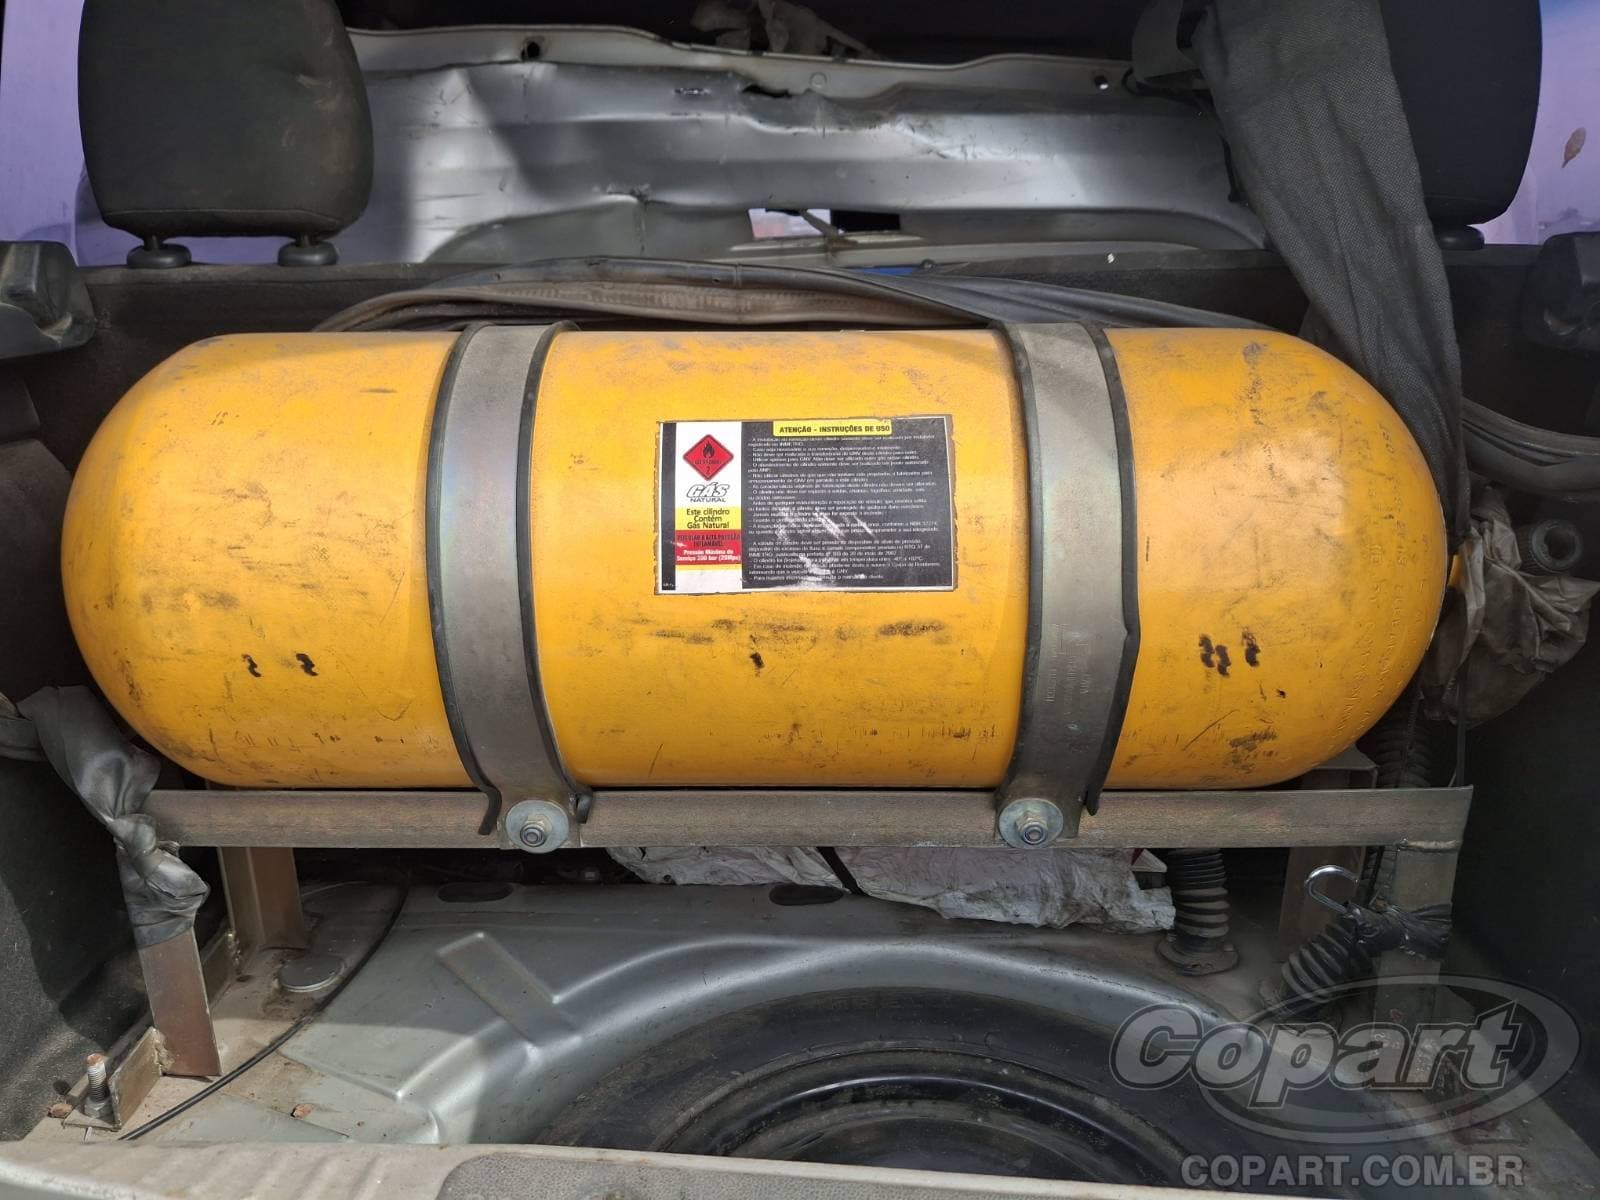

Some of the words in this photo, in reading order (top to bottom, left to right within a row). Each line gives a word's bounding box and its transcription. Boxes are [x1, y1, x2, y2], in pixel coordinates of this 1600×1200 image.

[779, 425, 812, 433] ATENÇÃO
[819, 424, 862, 433] INSTRUÇÕES
[686, 482, 730, 497] GÁS
[703, 508, 730, 516] cilindro
[686, 521, 700, 529] Gás
[702, 521, 730, 529] Natural
